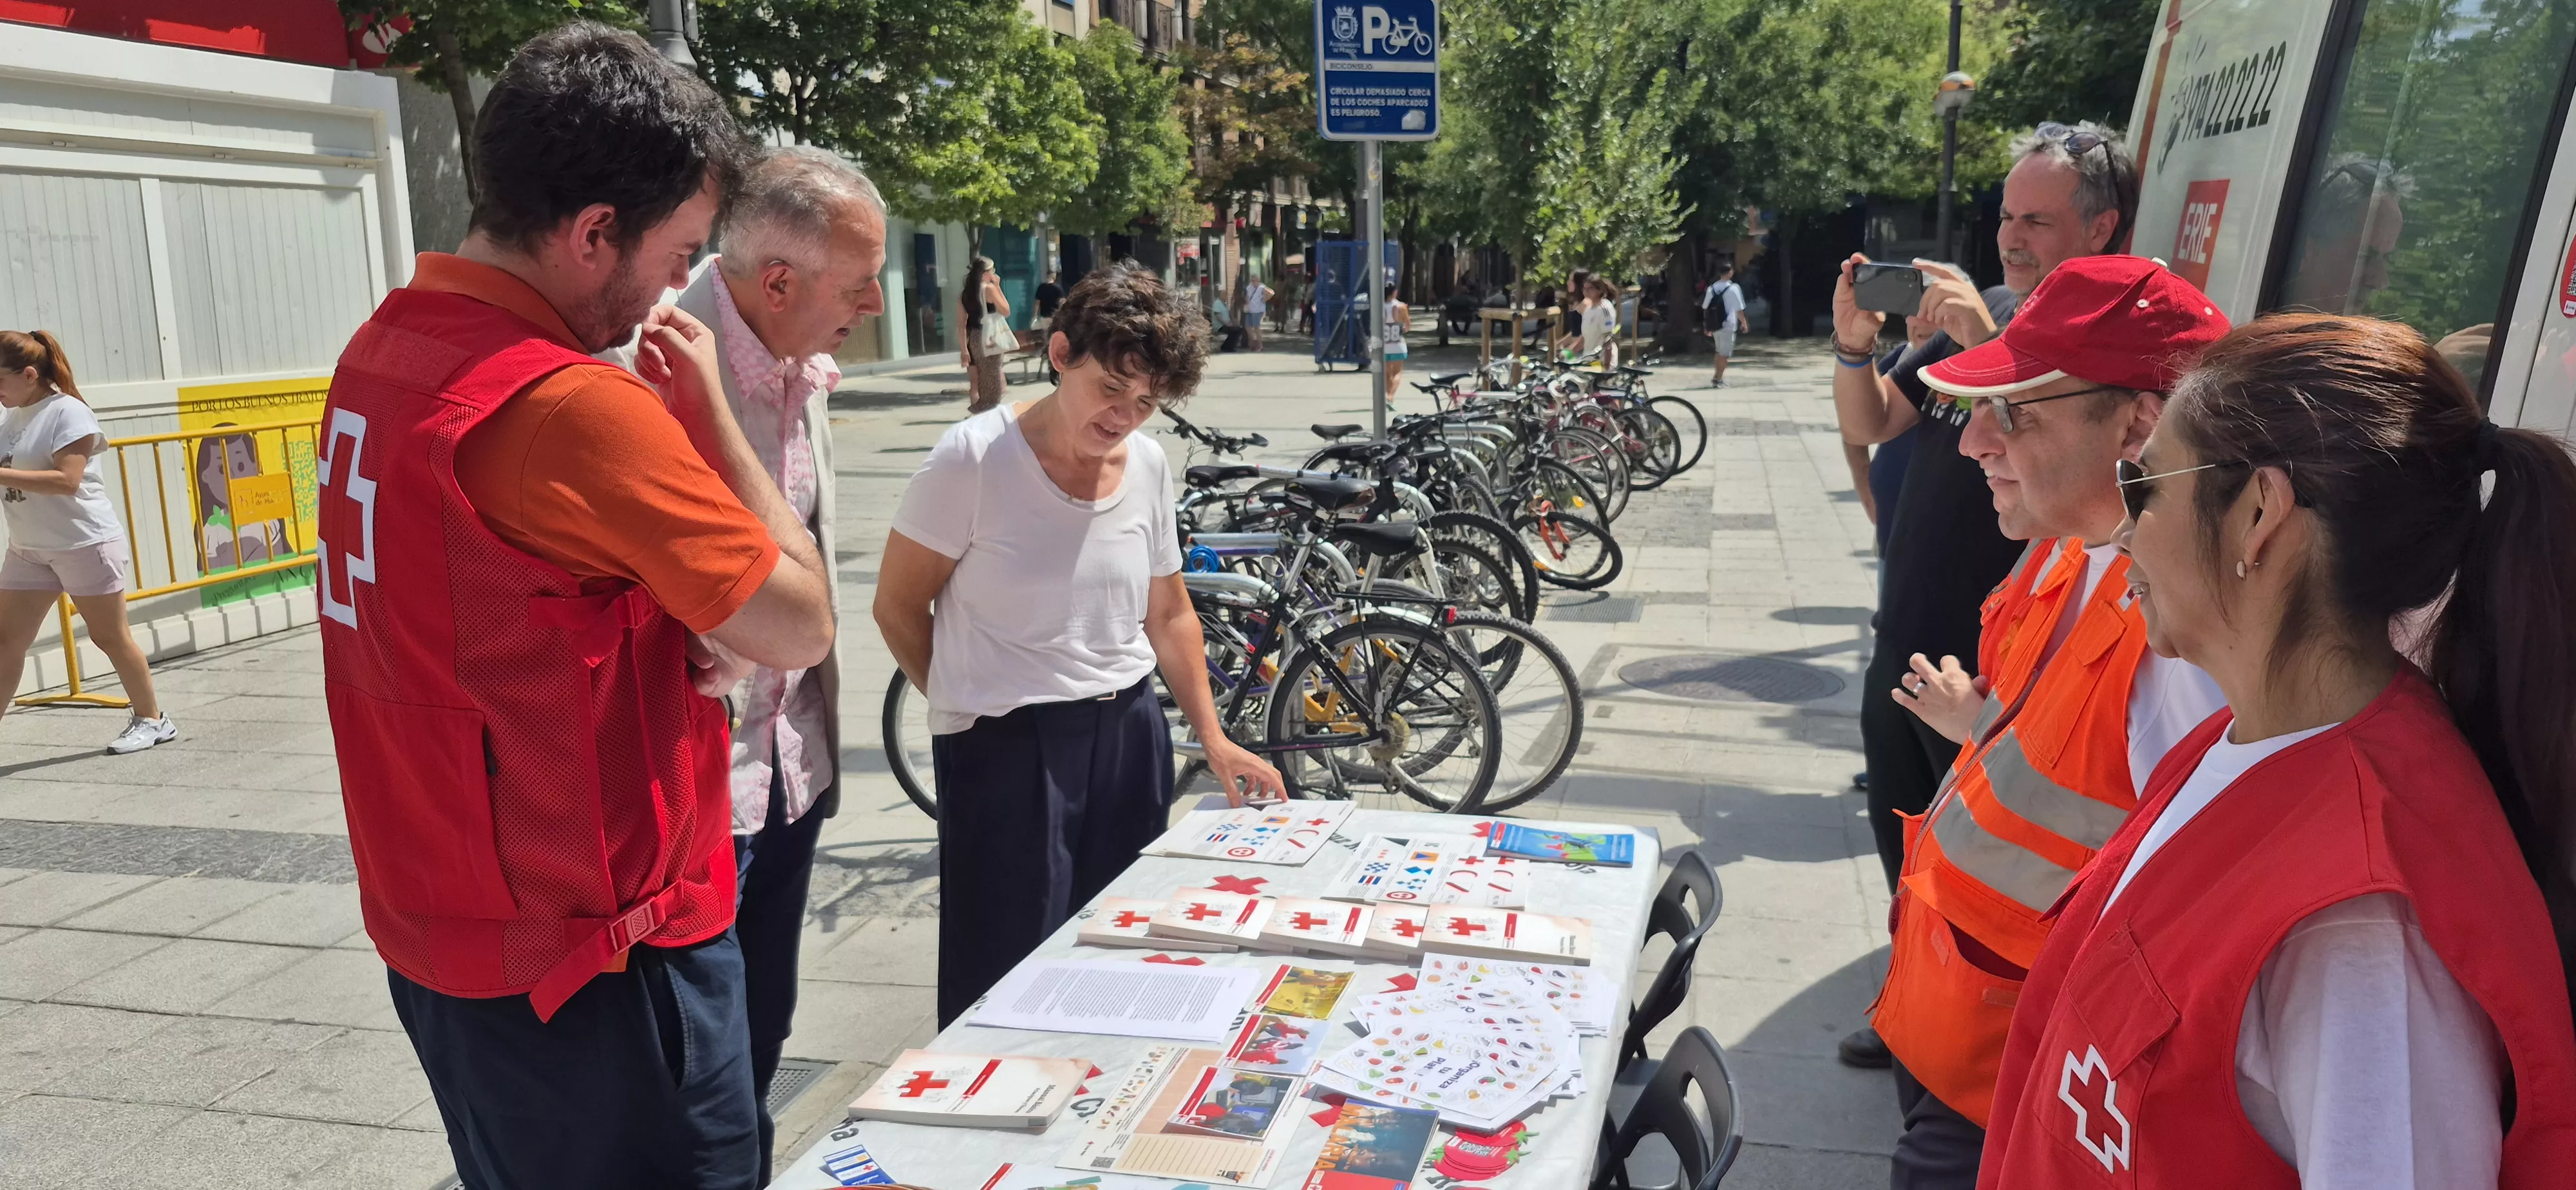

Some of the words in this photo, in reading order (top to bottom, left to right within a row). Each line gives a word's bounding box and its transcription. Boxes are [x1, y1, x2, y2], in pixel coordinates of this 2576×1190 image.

[1362, 6, 1390, 54] P
[1330, 88, 1365, 96] CIRCULAR
[1366, 88, 1406, 97] DEMASIADO
[1408, 88, 1431, 97] CERCA
[1331, 98, 1340, 106] DE
[1341, 98, 1356, 106] LOS
[1357, 99, 1386, 107] COCHES
[1387, 99, 1429, 107] APARCADOS
[2202, 62, 2236, 138] 22
[2223, 53, 2259, 134] 22
[2246, 41, 2286, 129] 22
[1341, 109, 1382, 117] PELIGROSO.
[2178, 202, 2218, 264] ERIE
[1442, 1066, 1453, 1075] tu
[1313, 1102, 1363, 1171] MALARIA
